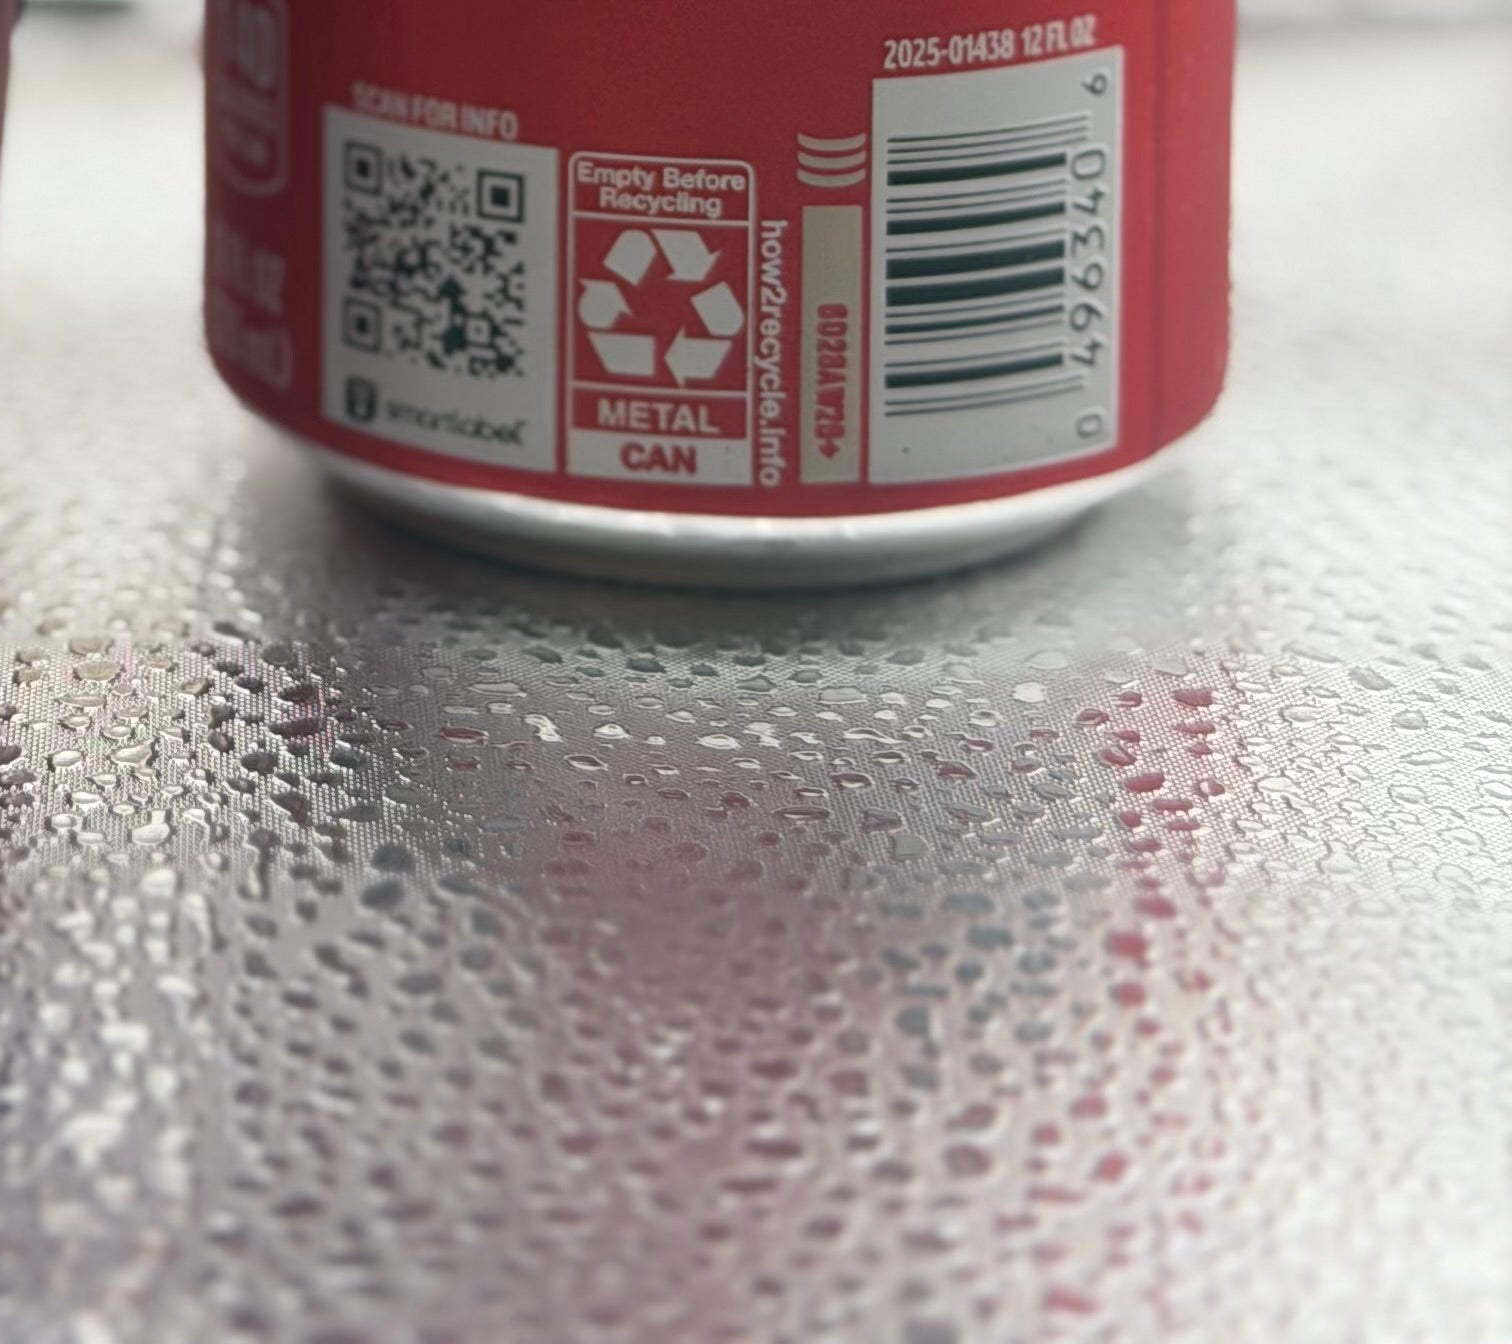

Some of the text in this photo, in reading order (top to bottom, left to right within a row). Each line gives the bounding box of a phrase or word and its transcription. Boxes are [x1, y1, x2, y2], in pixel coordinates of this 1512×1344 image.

[884, 28, 1015, 69] 2025-01438
[1022, 24, 1043, 56] 12
[1046, 20, 1067, 51] FL
[461, 104, 518, 141] INFO
[578, 162, 746, 191] Empty Before
[599, 187, 721, 219] Recycling
[755, 219, 788, 486] how2recycle.info
[598, 399, 719, 433] METAL
[620, 443, 697, 475] CAN
